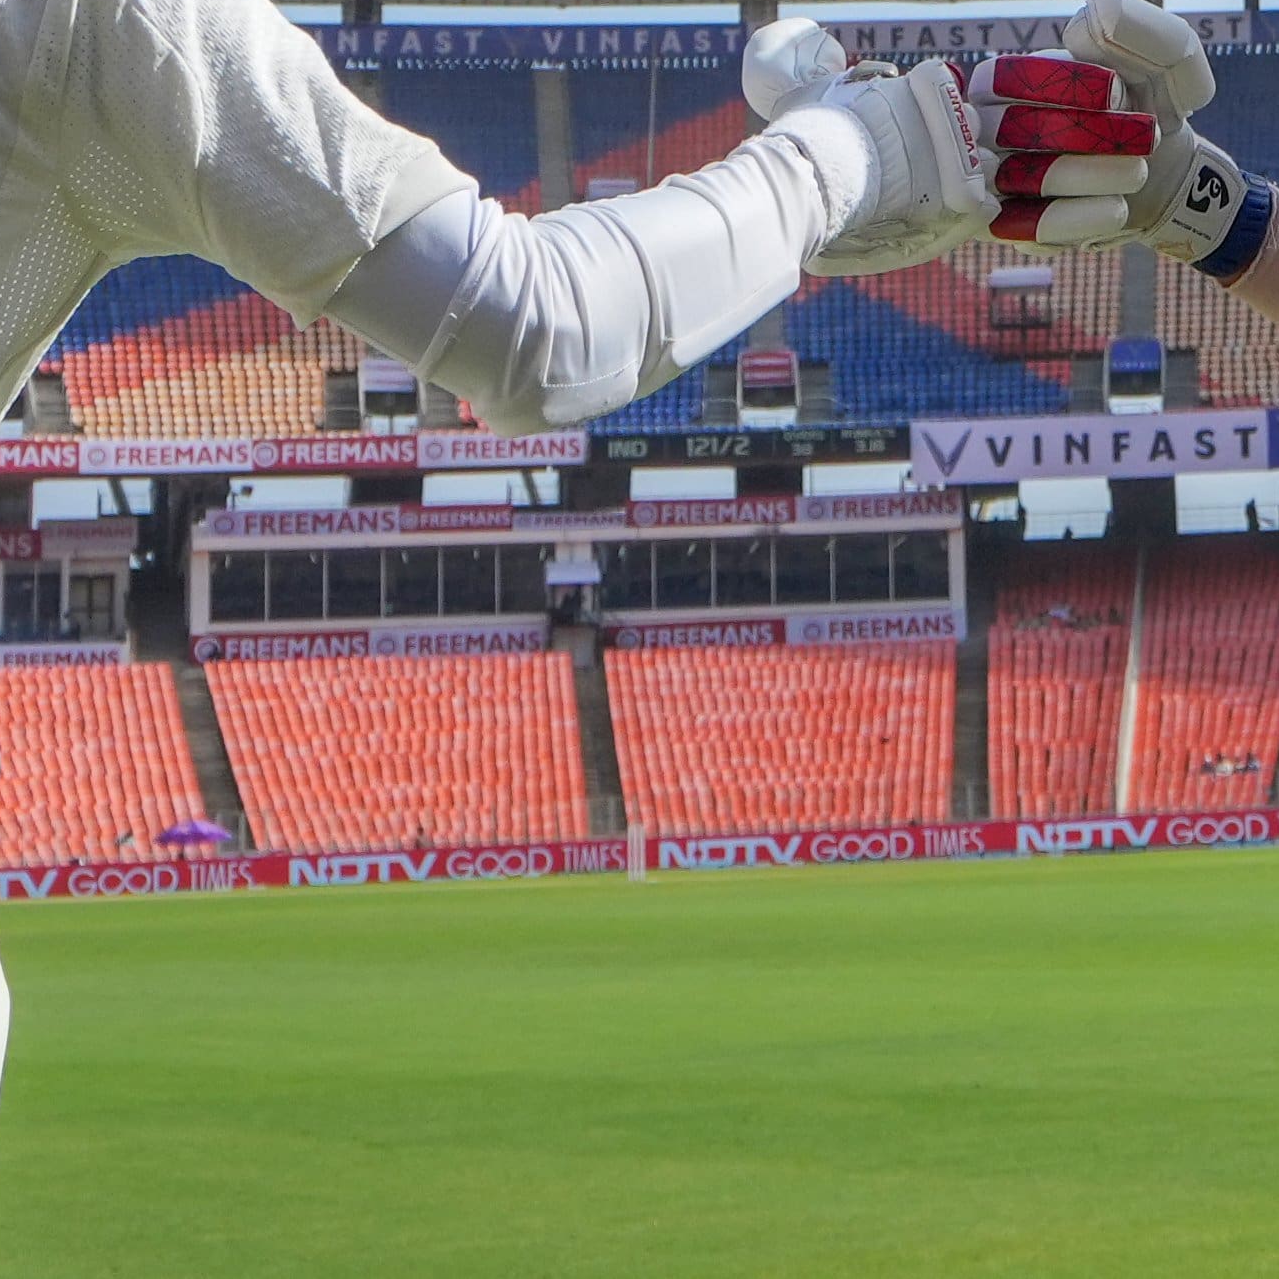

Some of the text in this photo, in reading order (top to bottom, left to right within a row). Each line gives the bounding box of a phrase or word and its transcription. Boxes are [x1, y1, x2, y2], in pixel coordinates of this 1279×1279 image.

[542, 28, 740, 54] VINFAST
[946, 86, 974, 153] VERSANT
[115, 444, 251, 466] FREEMANS
[282, 438, 417, 467] FREEMANS
[451, 438, 581, 459] FREEMANS
[686, 435, 751, 458] 121/2
[985, 427, 1257, 465] VINFAST
[419, 510, 511, 528] FREEMANS
[662, 501, 790, 525] FREEMANS
[833, 494, 957, 519] FREEMANS
[244, 511, 396, 535] FREEMANS
[644, 624, 773, 647] FREEMANS
[830, 616, 953, 639] FREEMANS
[225, 636, 368, 662] FREEMANS
[405, 632, 542, 655] FREEMANS
[1017, 819, 1158, 853] NDTV
[1167, 815, 1270, 847] GOOD
[659, 825, 986, 869] NDTV GOOD TIMES
[288, 842, 627, 888] NDTV GOOD TIMES
[67, 865, 180, 898] GOOD
[190, 861, 257, 894] TIMES
